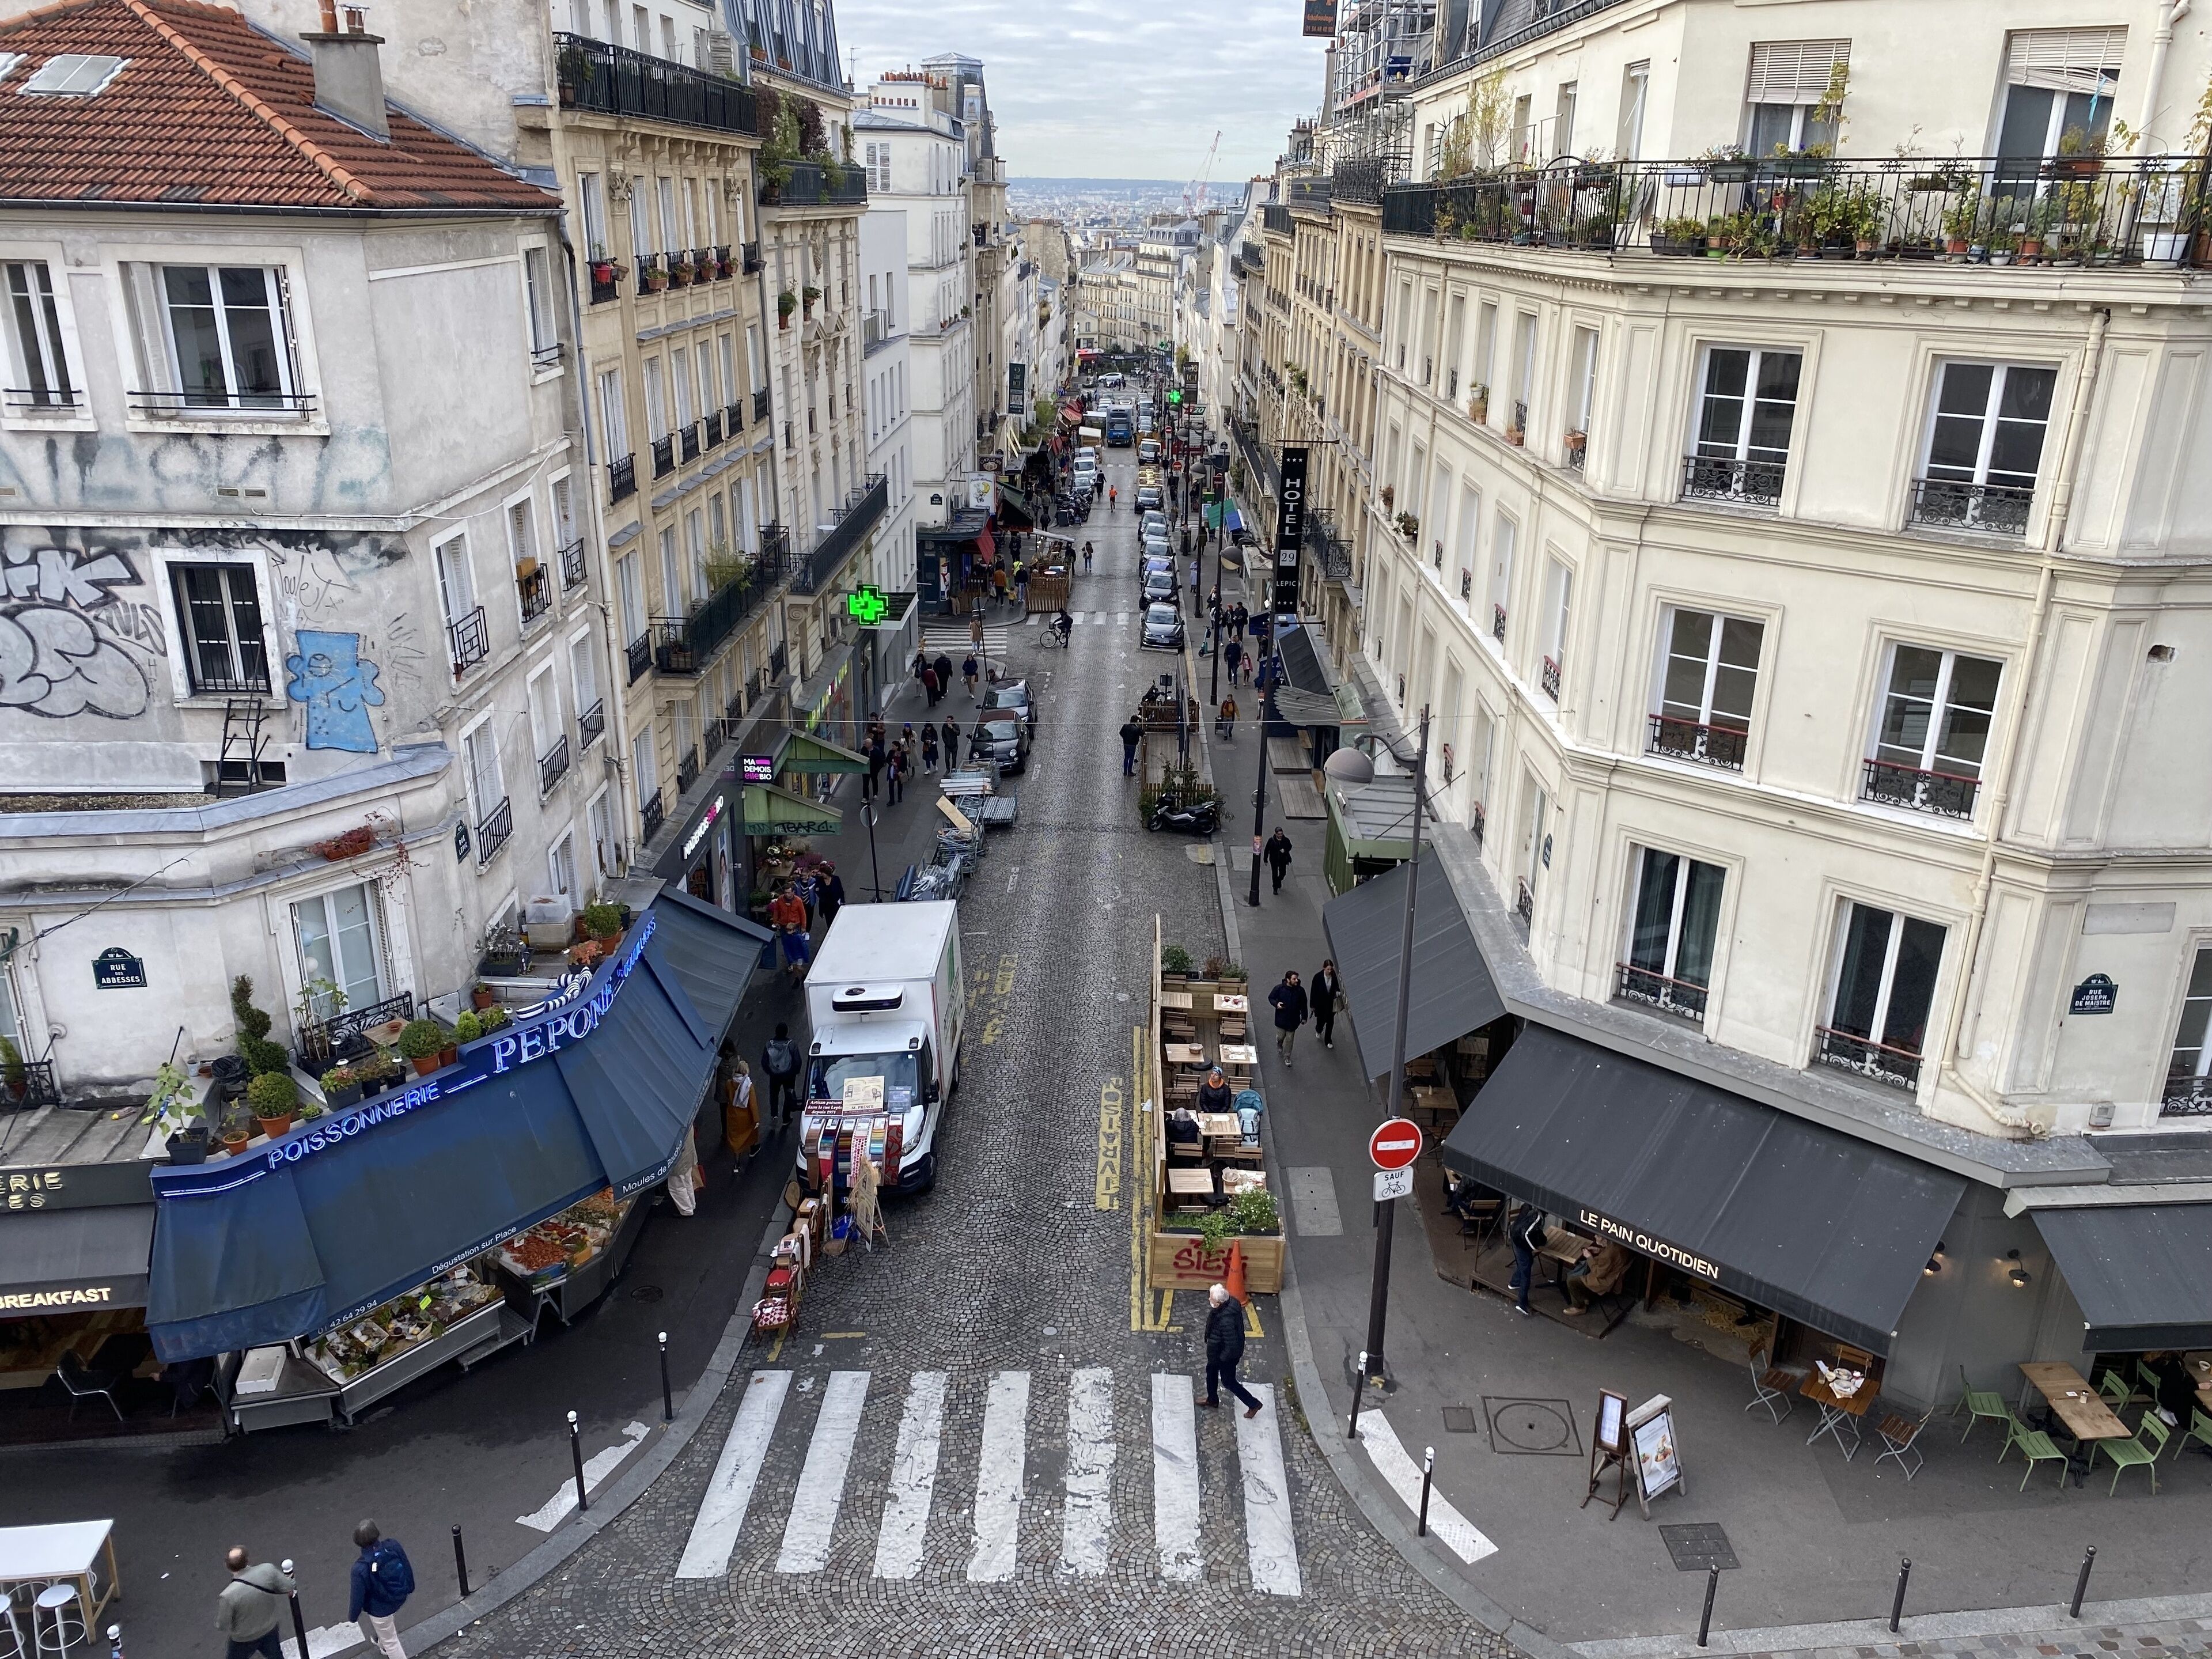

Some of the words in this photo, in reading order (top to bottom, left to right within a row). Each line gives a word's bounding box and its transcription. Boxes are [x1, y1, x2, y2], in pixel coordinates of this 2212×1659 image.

[1283, 478, 1301, 536] HOTEL
[1281, 552, 1295, 562] 29
[101, 976, 140, 984] ABBESSES
[268, 1080, 441, 1169] POISSONNERIE
[1100, 1077, 1123, 1207] LIVRAISON
[623, 1173, 655, 1194] Moules
[657, 1166, 667, 1176] de
[1385, 1171, 1404, 1181] SAUF
[0, 1193, 45, 1209] ES
[432, 1244, 479, 1275] Dégustation
[481, 1237, 494, 1249] sur
[495, 1226, 517, 1241] Place
[1580, 1209, 1598, 1228] LE
[1600, 1218, 1633, 1243] PAIN
[1635, 1234, 1719, 1279] QUOTIDIEN
[329, 1317, 342, 1328] 42
[343, 1312, 354, 1322] 64
[355, 1305, 366, 1316] 29
[366, 1299, 377, 1309] 94
